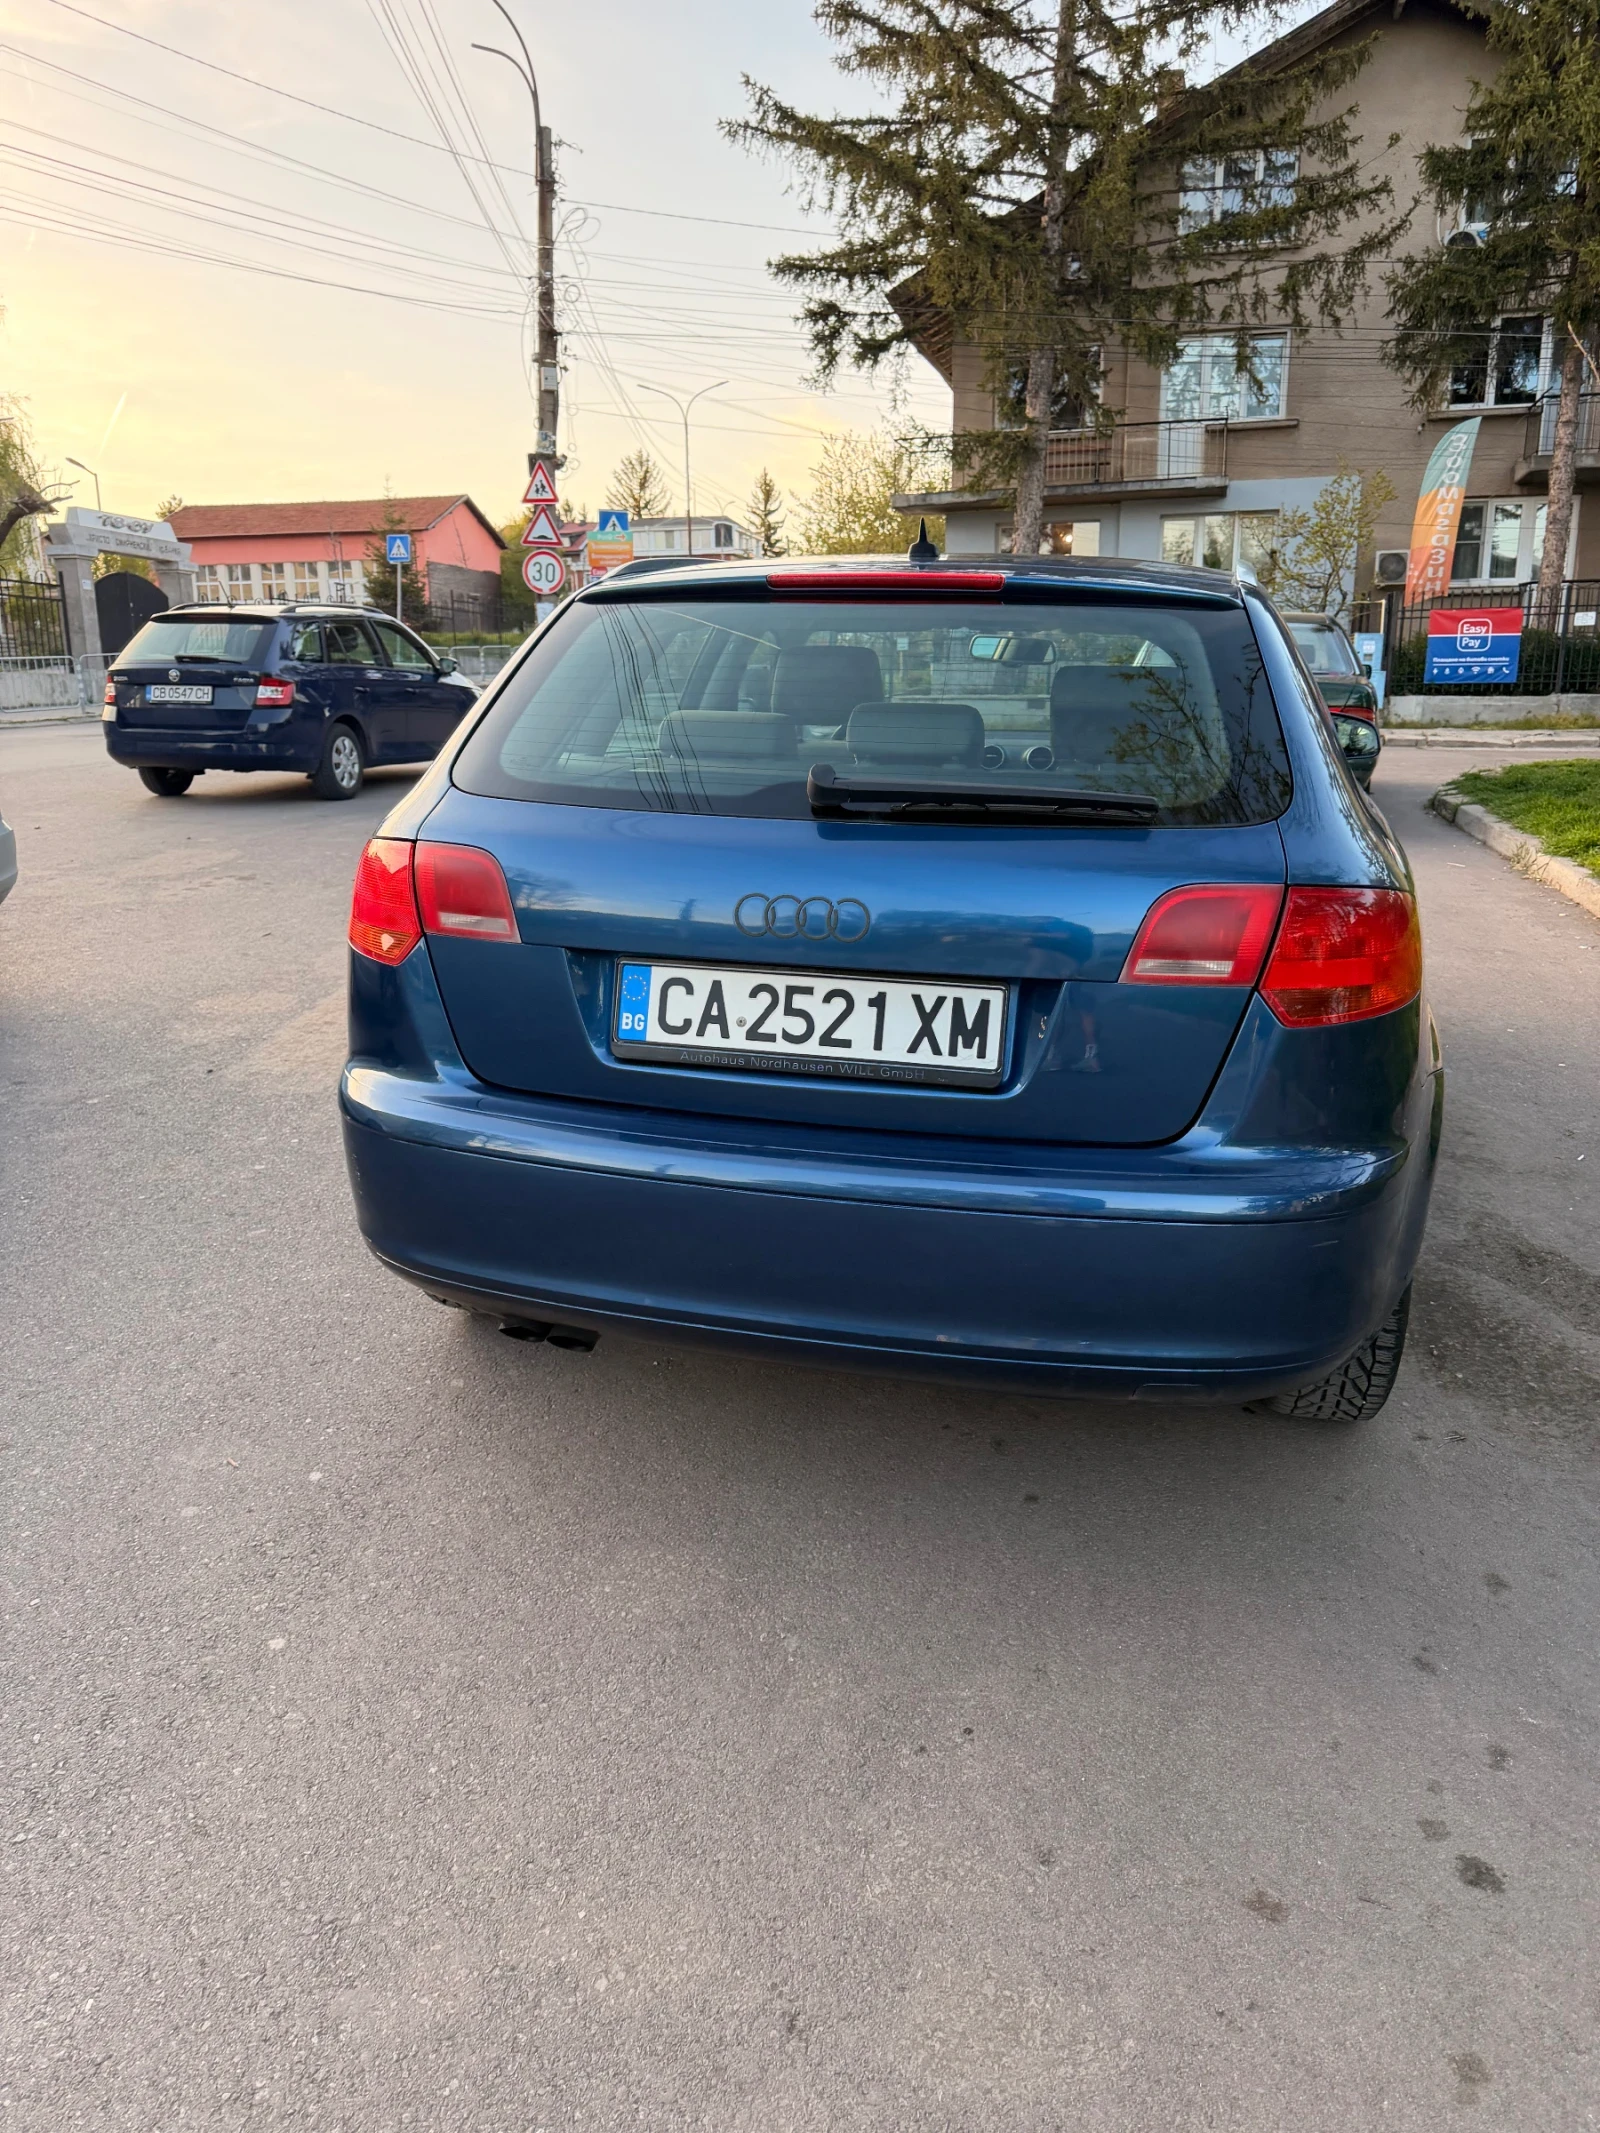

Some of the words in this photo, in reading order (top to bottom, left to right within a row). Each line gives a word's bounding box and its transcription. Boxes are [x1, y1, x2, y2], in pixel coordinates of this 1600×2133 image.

[532, 561, 555, 583] 30
[1463, 624, 1487, 634] Easy
[1462, 637, 1481, 648] Pay
[153, 687, 166, 699] CB
[168, 687, 194, 699] 0547
[195, 688, 210, 699] CH
[621, 1013, 645, 1031] BG
[657, 977, 730, 1039] CA
[745, 983, 887, 1052] 2521
[906, 993, 991, 1059] XM
[680, 1051, 745, 1066] Autohaus
[750, 1056, 833, 1073] Nordhausen
[839, 1064, 874, 1076] WILL
[880, 1068, 925, 1080] GmbH
